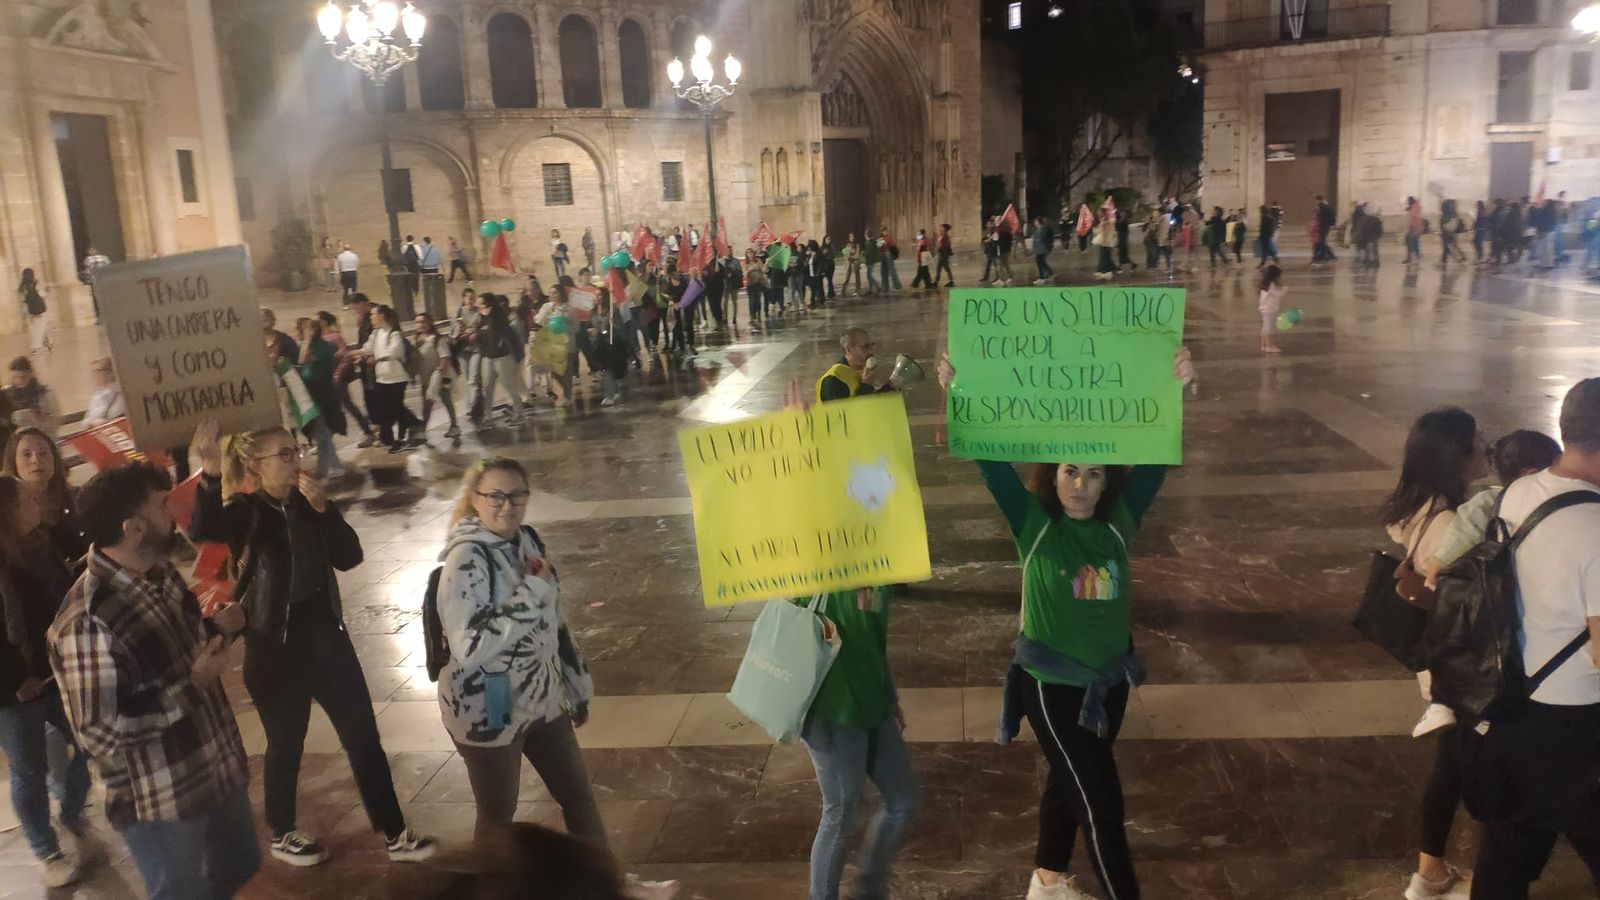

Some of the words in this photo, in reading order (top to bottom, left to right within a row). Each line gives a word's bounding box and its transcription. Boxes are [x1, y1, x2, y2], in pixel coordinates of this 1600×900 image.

[141, 275, 209, 306] TENGO
[963, 298, 1011, 326] POR
[1023, 299, 1054, 325] UN
[1059, 290, 1175, 330] SALARIO
[172, 347, 227, 377] COMO
[971, 334, 1055, 360] ACORDE
[1080, 336, 1096, 358] A
[1011, 362, 1124, 390] NUESTRA
[143, 377, 255, 425] MORTADELA
[952, 395, 1160, 424] RESPONSABILIDAD
